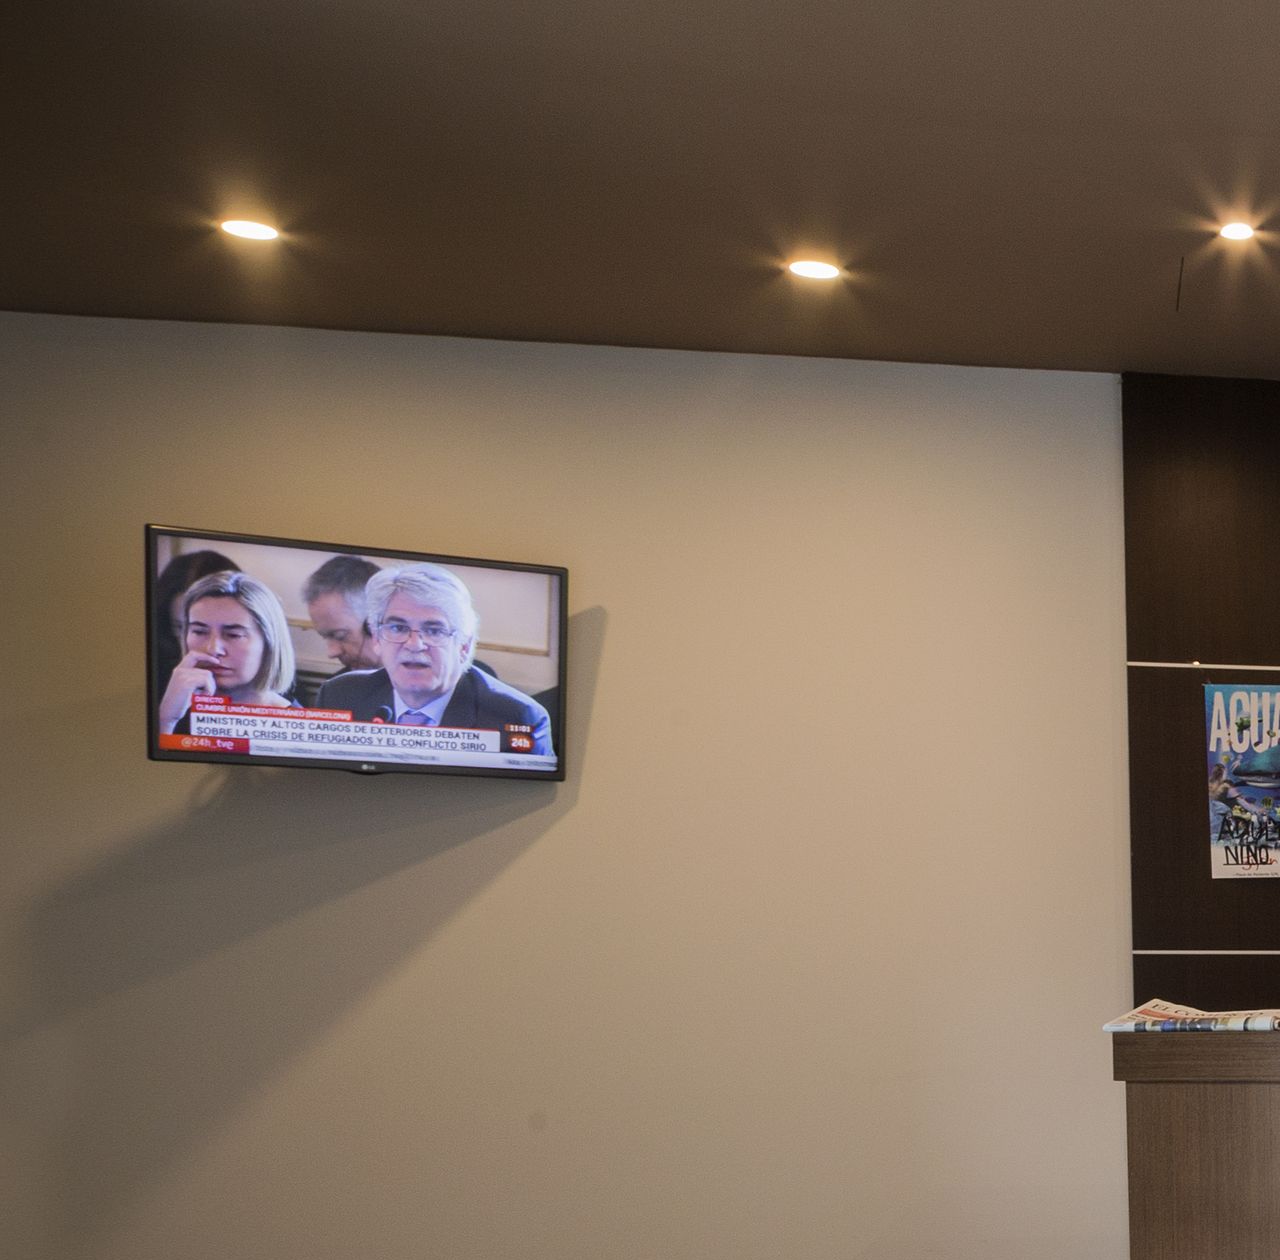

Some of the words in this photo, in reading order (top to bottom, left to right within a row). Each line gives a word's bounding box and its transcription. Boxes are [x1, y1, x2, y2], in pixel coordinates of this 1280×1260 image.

[194, 696, 224, 704] DIRECTO
[196, 703, 226, 713] CUMBRE
[227, 704, 250, 714] UNIÓN
[196, 716, 257, 727] MINISTROS
[260, 719, 268, 727] Y
[271, 720, 305, 730] ALTOS
[308, 723, 351, 733] CARGOS
[354, 725, 367, 734] DE
[371, 727, 432, 738] EXTERIORES
[435, 730, 480, 741] DEBATEN
[181, 739, 234, 750] @24h_tve
[196, 727, 232, 737] SOBRE
[236, 728, 249, 737] LA
[253, 730, 287, 740] CRISIS
[291, 732, 305, 741] DE
[307, 733, 373, 745] REFUGIADOS
[376, 736, 383, 745] Y
[386, 737, 397, 746] EL
[401, 738, 457, 750] CONFLICTO
[460, 742, 487, 751] SIRIO
[511, 739, 530, 748] 24h
